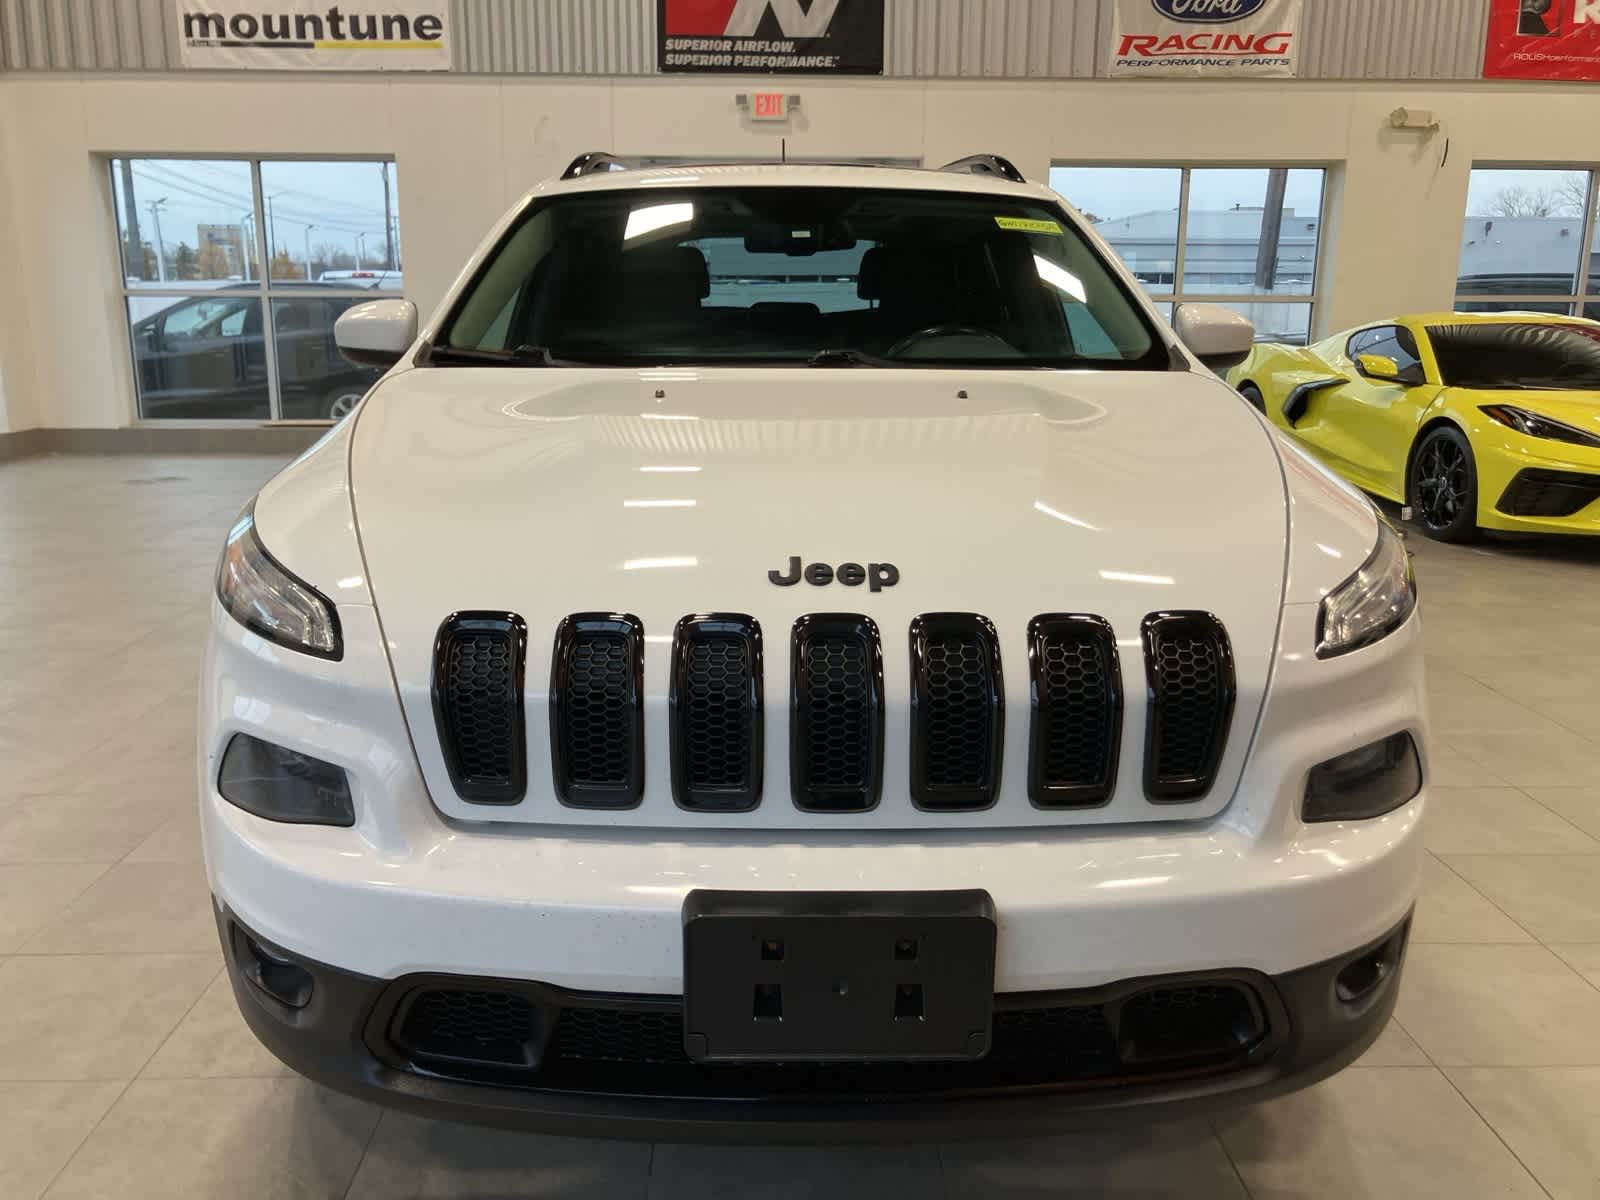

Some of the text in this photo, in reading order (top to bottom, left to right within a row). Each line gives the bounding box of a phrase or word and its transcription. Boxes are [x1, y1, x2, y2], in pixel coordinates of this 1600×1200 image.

[184, 6, 443, 40] mountune
[665, 39, 796, 53] SUPERIOR AIRFLOW.
[1118, 33, 1292, 56] RACING
[665, 54, 732, 65] SUPERIOR
[1116, 58, 1290, 67] PERFORMANCE PARTS
[755, 93, 783, 116] EXIT
[768, 556, 900, 592] Jeep
